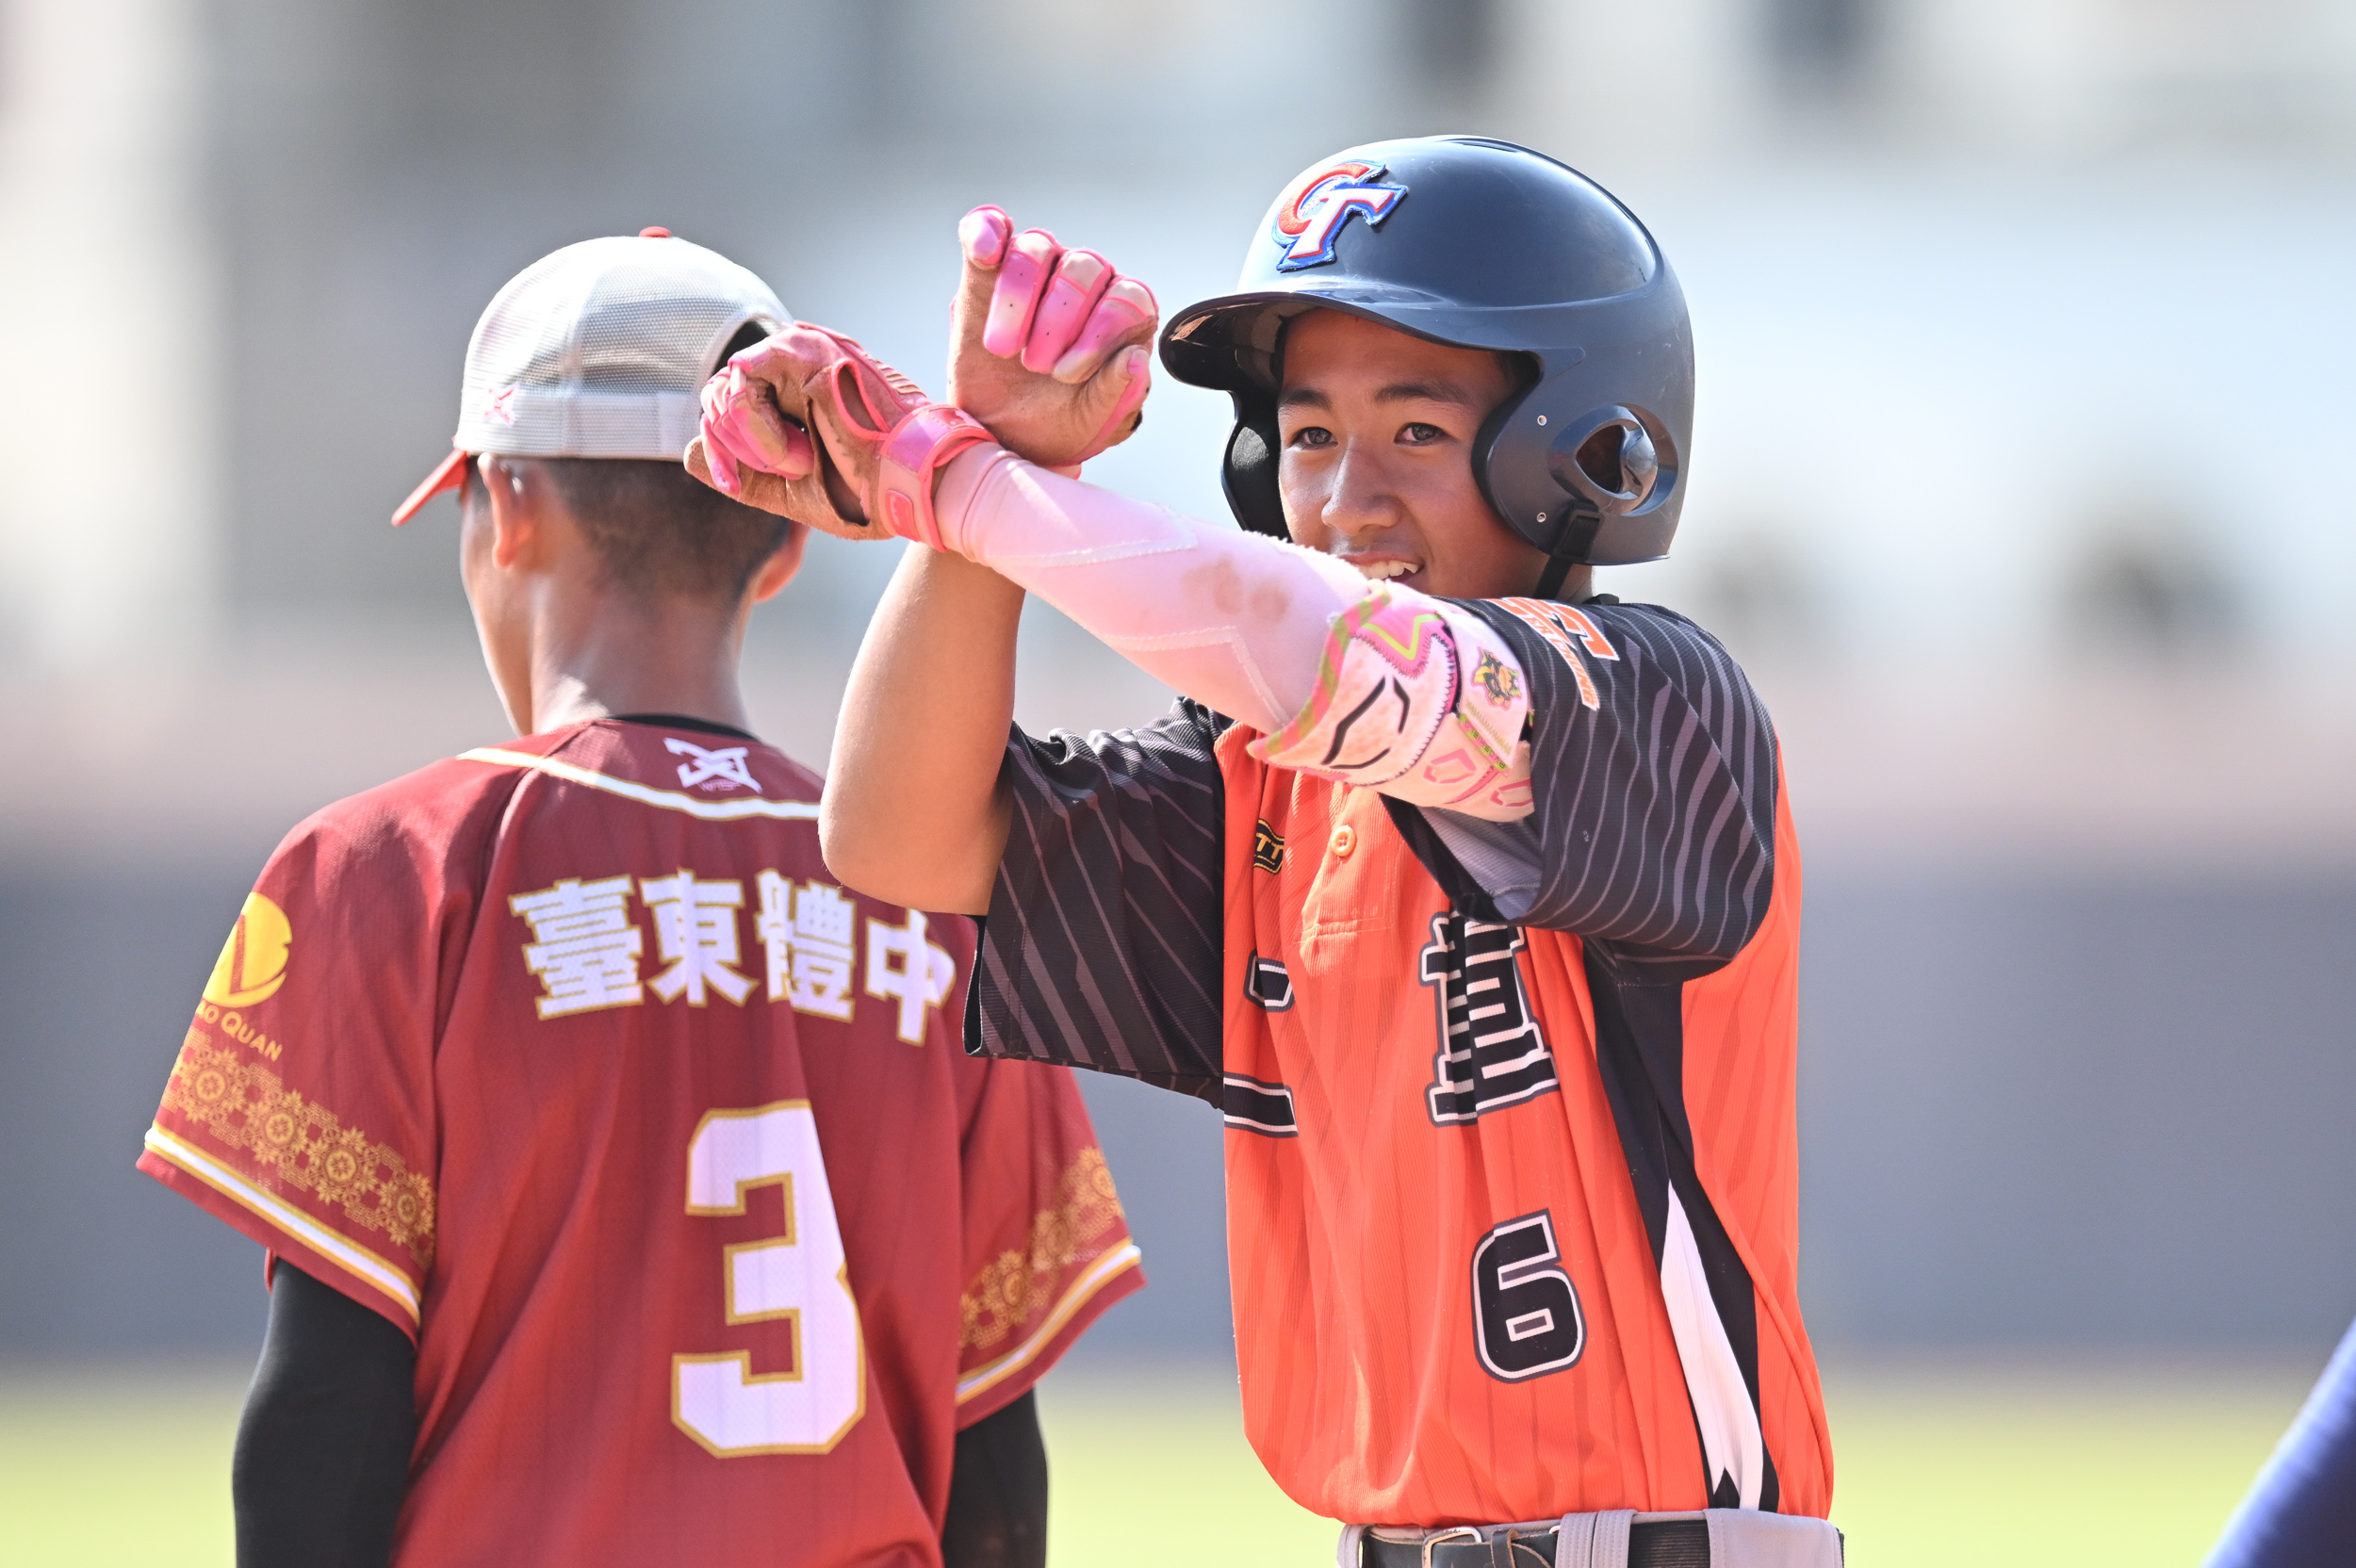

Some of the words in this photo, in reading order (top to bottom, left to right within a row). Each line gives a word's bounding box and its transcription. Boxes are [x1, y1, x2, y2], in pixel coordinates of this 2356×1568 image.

[1256, 832, 1284, 860] TT
[221, 1011, 283, 1062] QUAN
[671, 1099, 867, 1460] 3
[1470, 1208, 1587, 1383] 6
